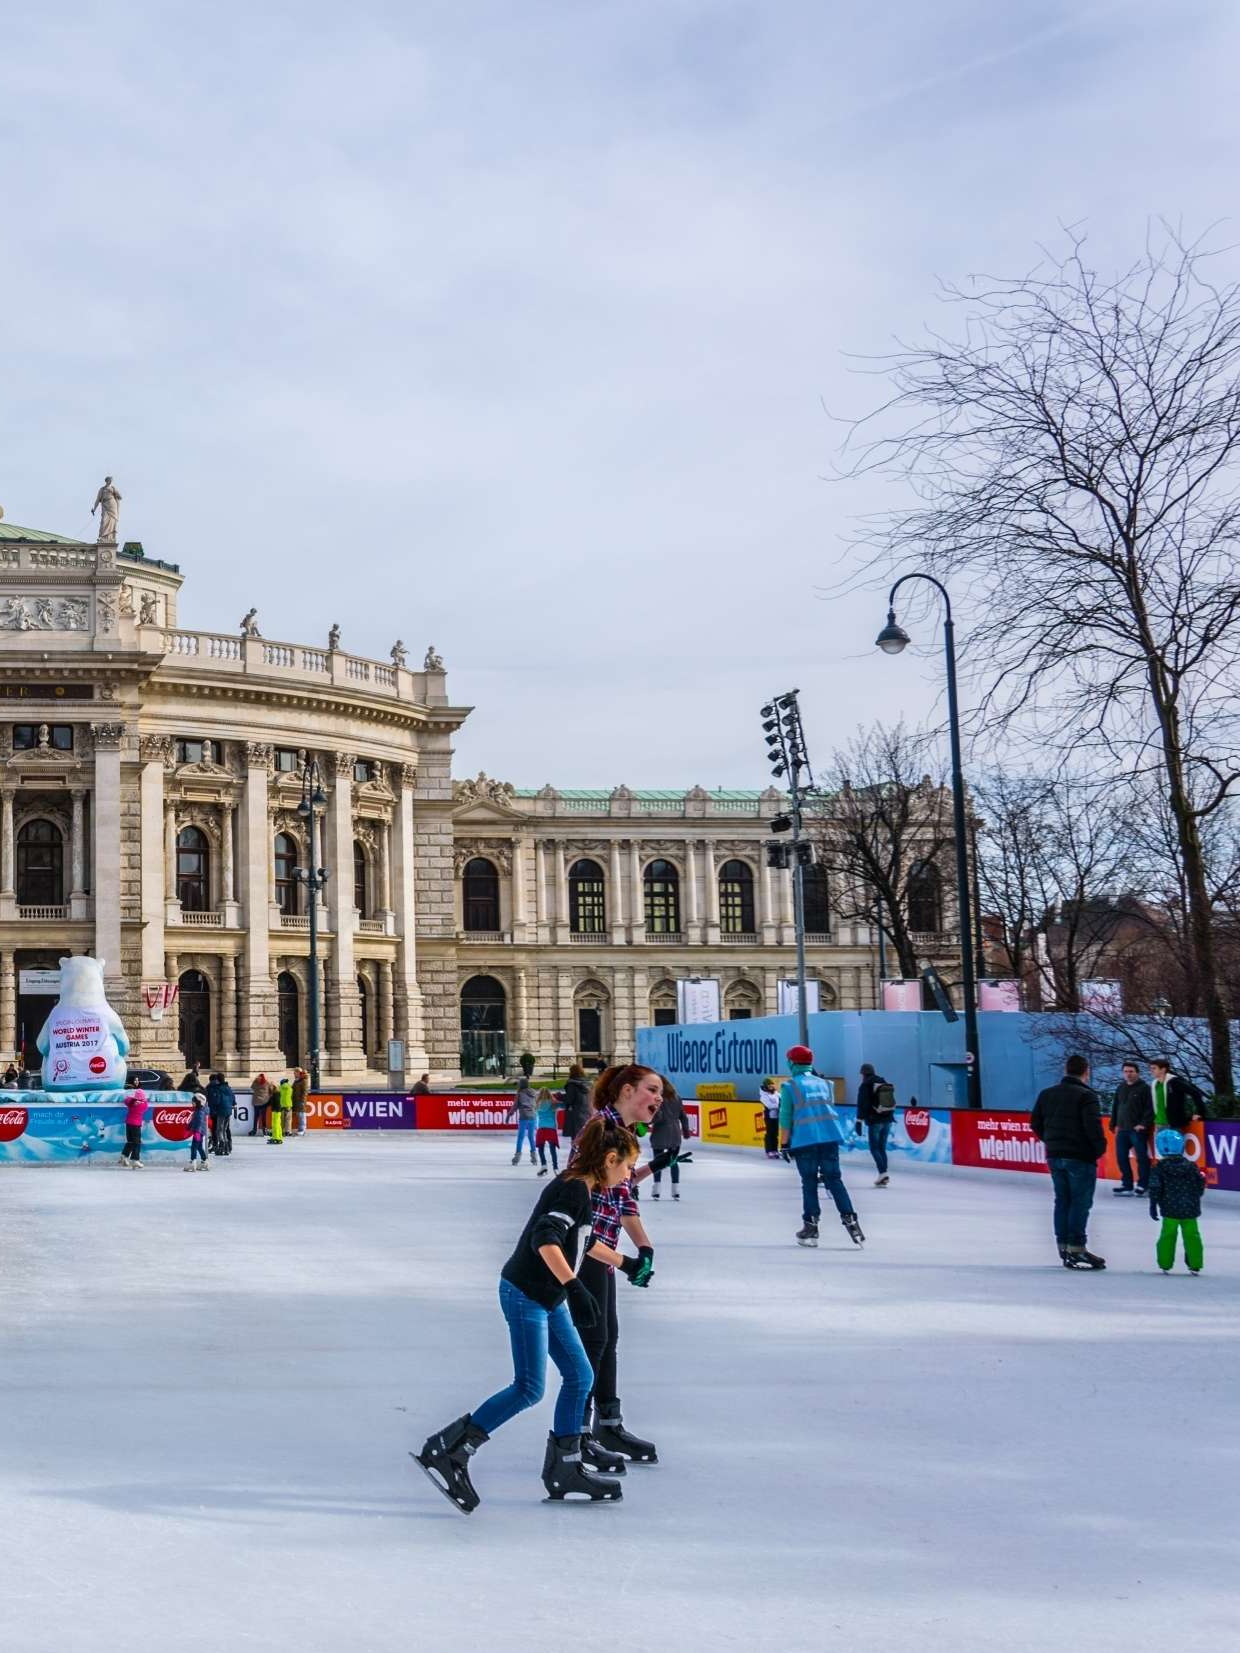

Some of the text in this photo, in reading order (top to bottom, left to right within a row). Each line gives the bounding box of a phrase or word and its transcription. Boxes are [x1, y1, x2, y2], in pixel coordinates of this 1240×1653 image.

[53, 1027, 75, 1035] WORLD
[65, 1033, 89, 1041] GAMES
[55, 1041, 81, 1049] AUSTRIA
[667, 1028, 778, 1075] Wiener Eistraum
[447, 1099, 471, 1107] mehr
[472, 1099, 494, 1107] wien
[346, 1101, 403, 1118] WIEN
[977, 1118, 999, 1131] mehr
[1000, 1119, 1021, 1132] wien
